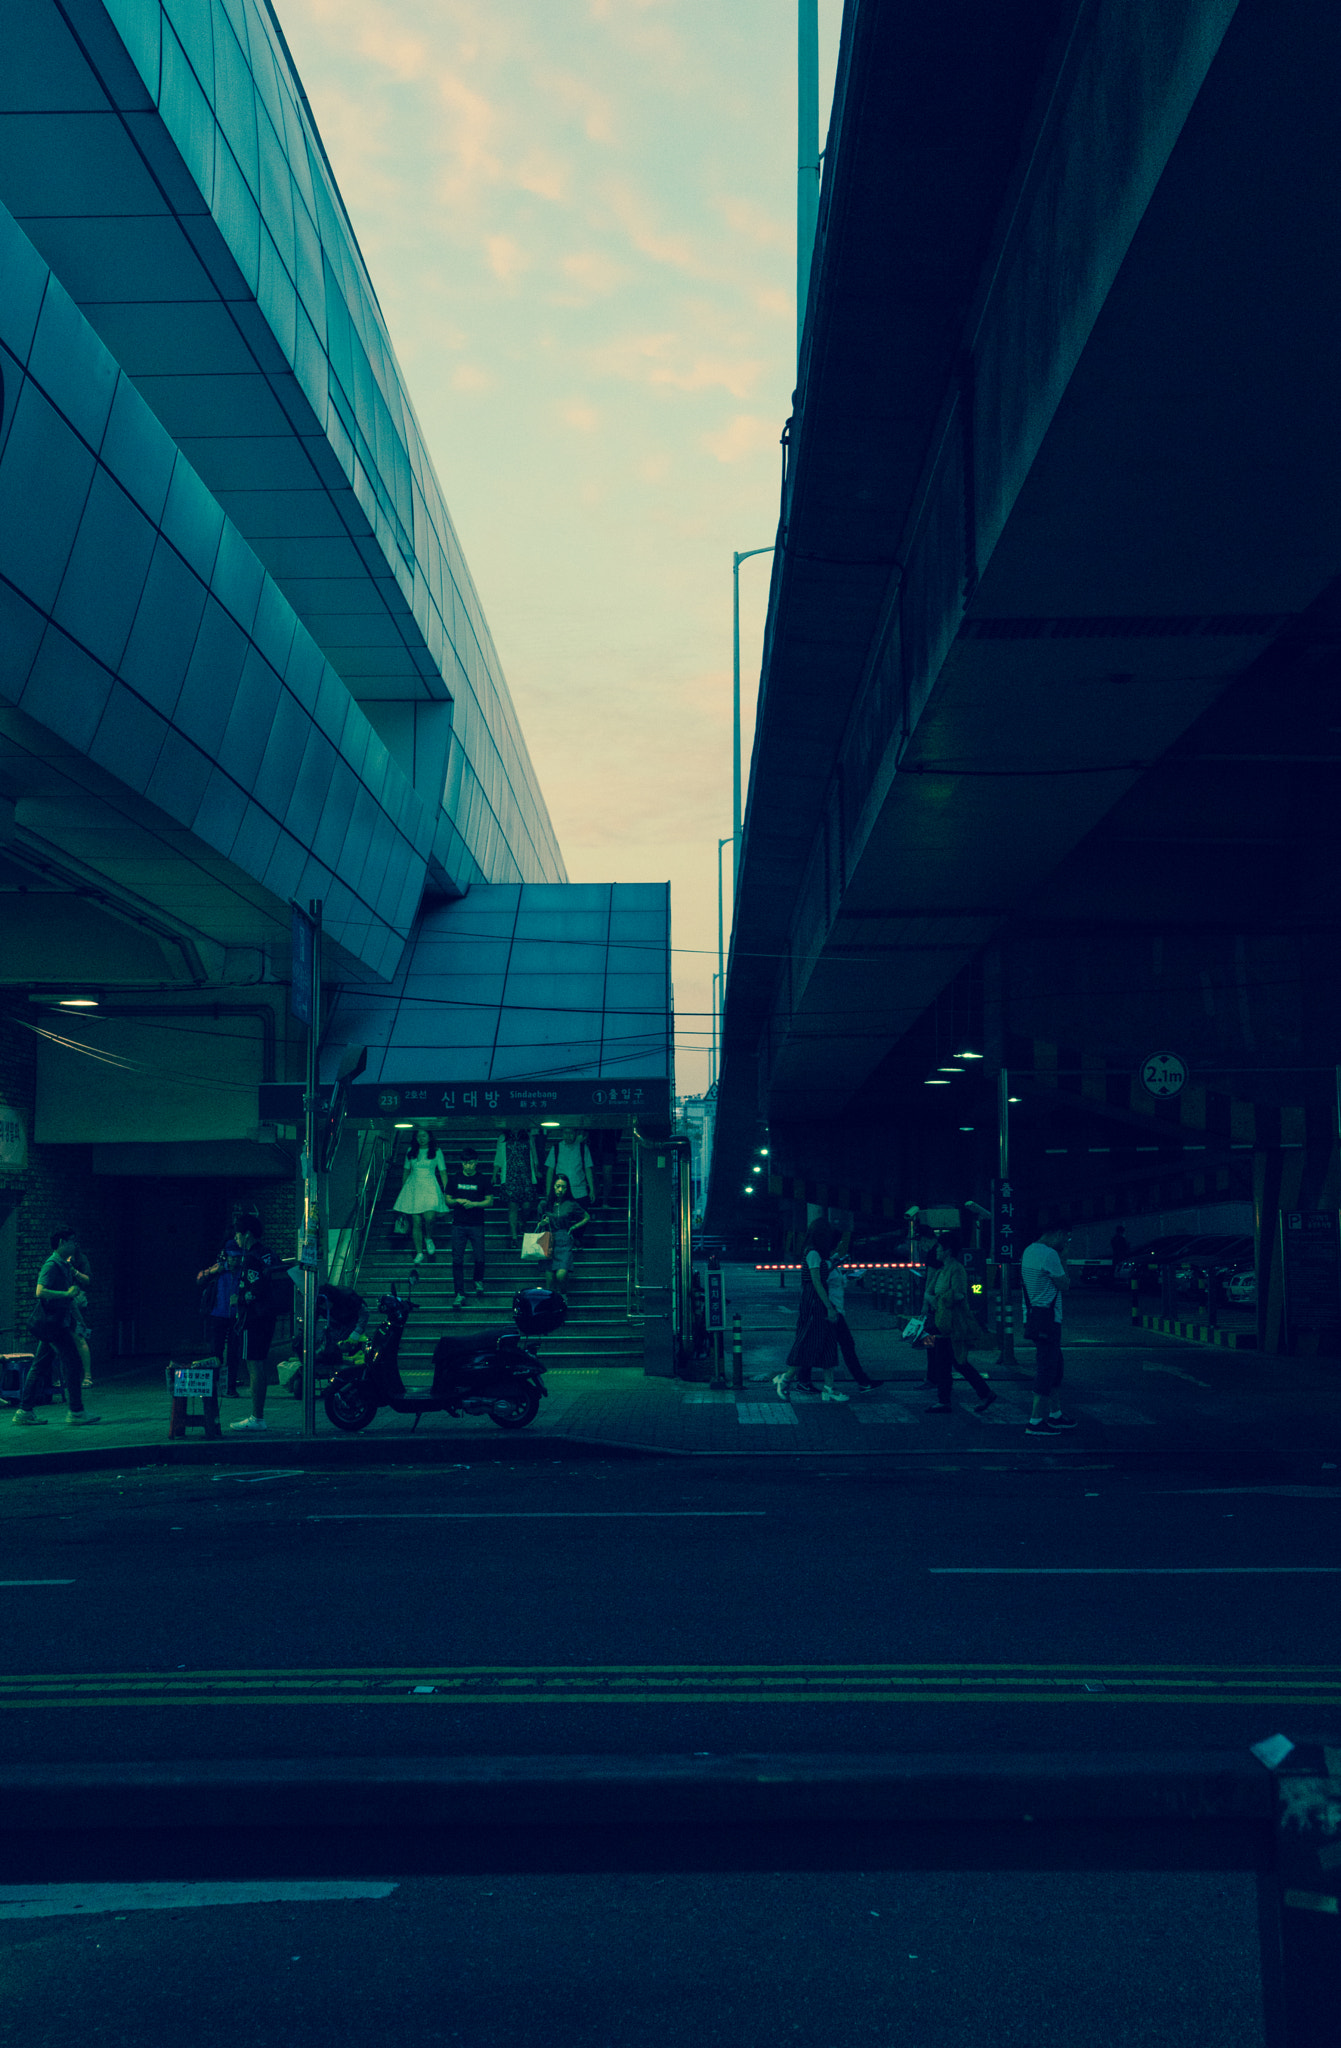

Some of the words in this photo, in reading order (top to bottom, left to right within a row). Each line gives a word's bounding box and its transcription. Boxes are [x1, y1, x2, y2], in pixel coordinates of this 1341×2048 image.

[1147, 1066, 1182, 1082] 2.1m
[405, 1090, 427, 1100] 2호선
[441, 1091, 500, 1109] 신대방
[510, 1090, 558, 1100] Sindaebang
[609, 1088, 644, 1101] 출입구
[381, 1096, 398, 1106] 231
[1000, 1182, 1014, 1259] 출차주의
[971, 1284, 983, 1294] 12
